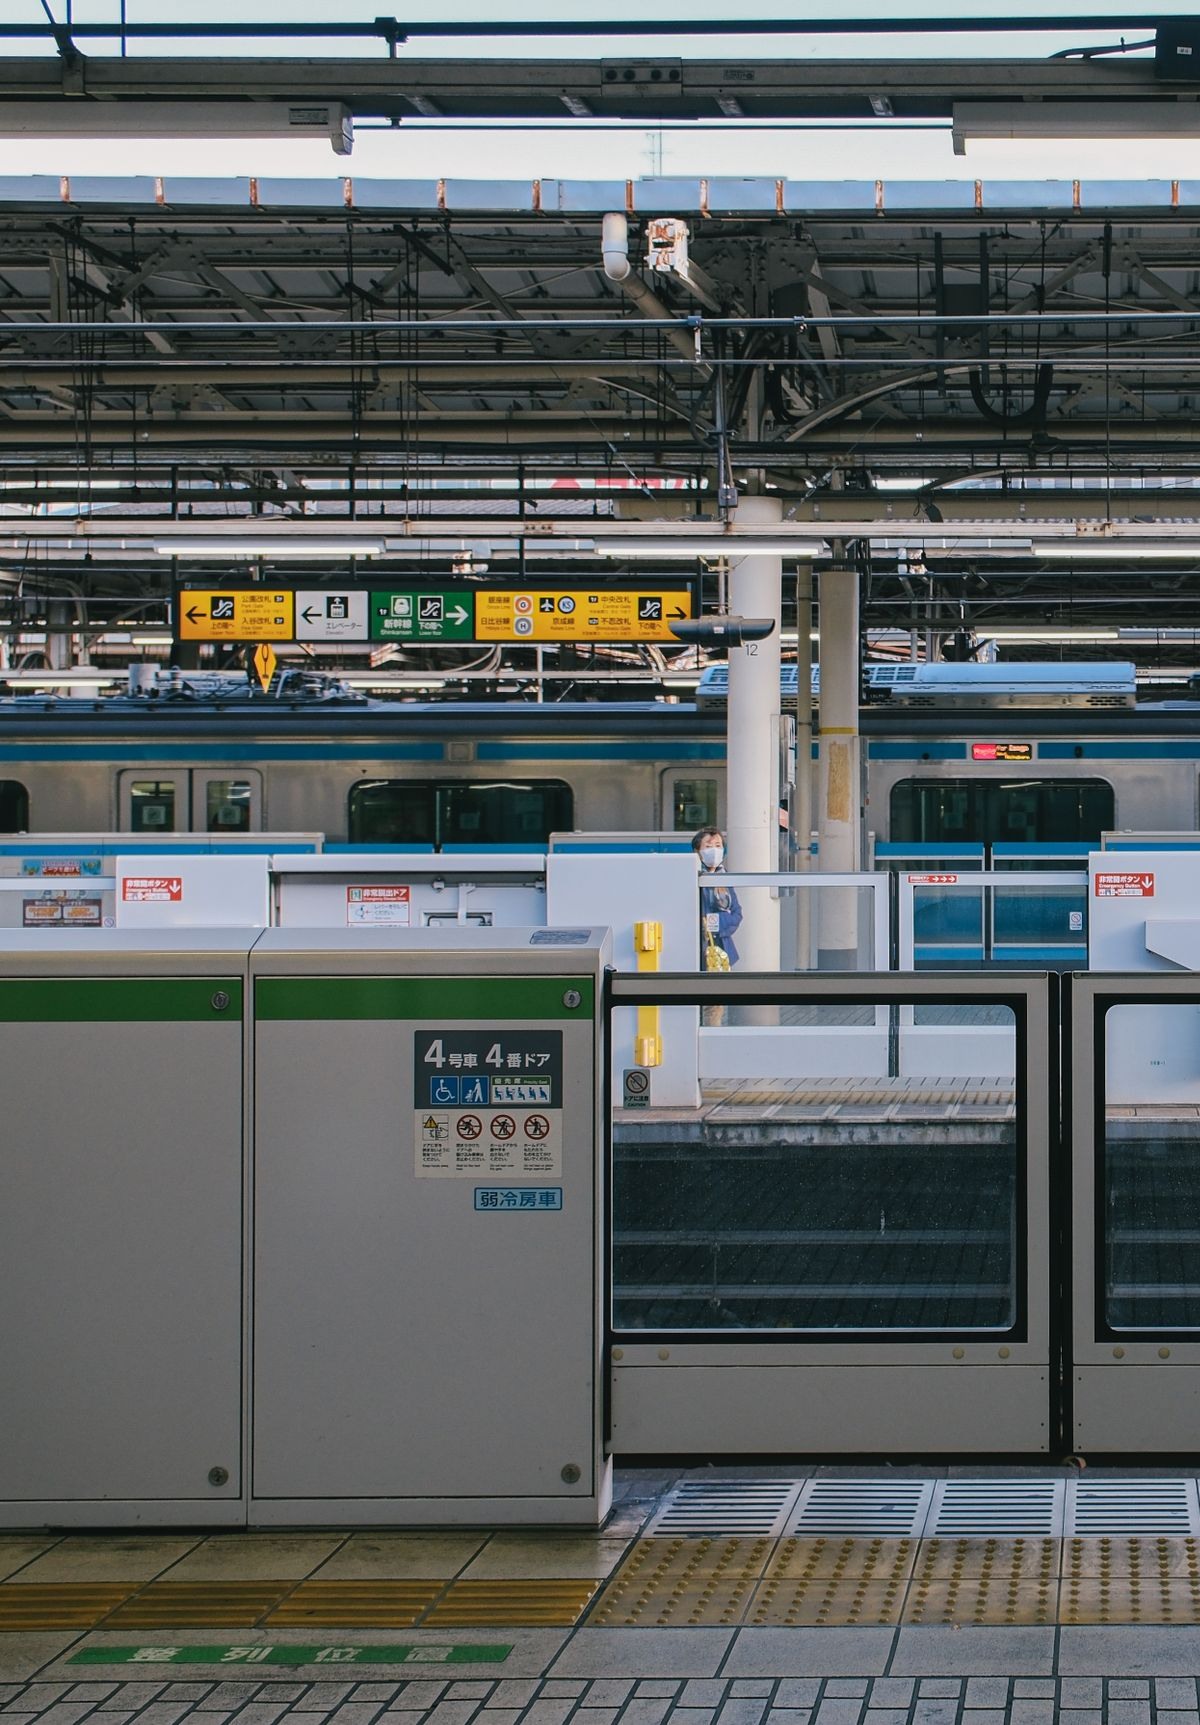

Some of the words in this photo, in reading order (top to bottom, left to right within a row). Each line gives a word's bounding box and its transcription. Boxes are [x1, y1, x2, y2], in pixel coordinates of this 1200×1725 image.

[562, 600, 571, 609] KS
[384, 619, 412, 628] 新幹線
[745, 644, 758, 656] 12
[424, 1039, 478, 1068] 4号車
[485, 1043, 550, 1068] 4番ドア
[481, 1192, 557, 1207] 弱冷房車
[130, 1647, 453, 1662] 整列位置
